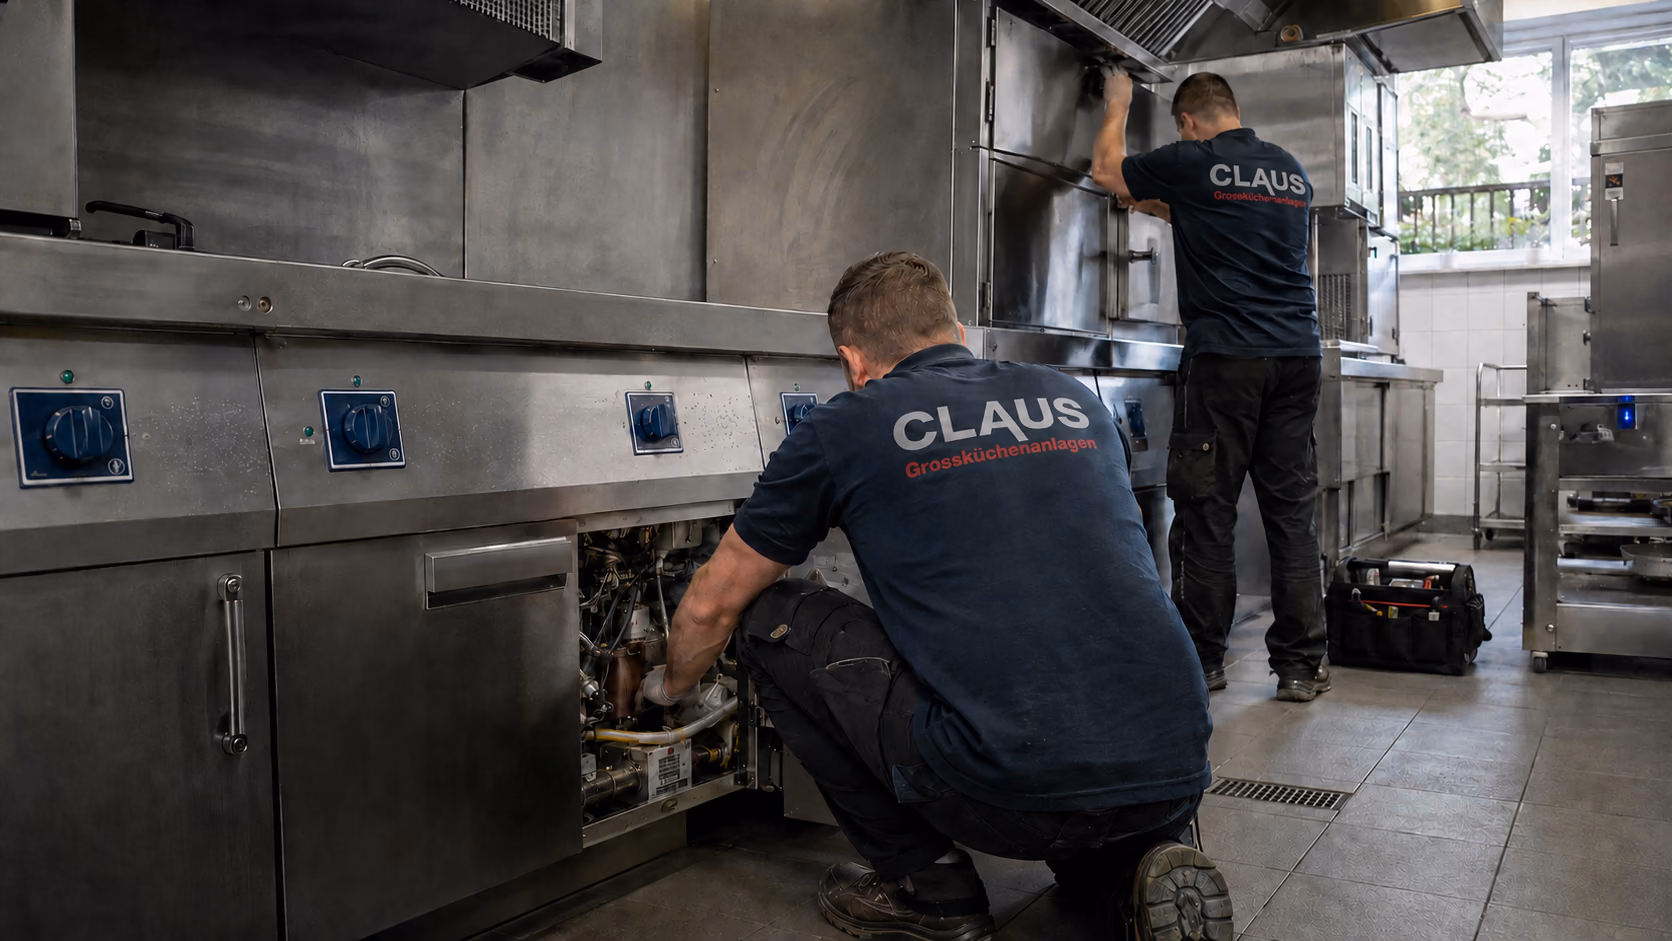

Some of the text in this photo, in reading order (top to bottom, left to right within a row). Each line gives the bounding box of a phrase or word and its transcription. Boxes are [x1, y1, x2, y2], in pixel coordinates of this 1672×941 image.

[1210, 163, 1306, 196] CLAUS
[893, 398, 1090, 451] CLAUS
[905, 437, 1097, 478] Grossküchenanlagen
